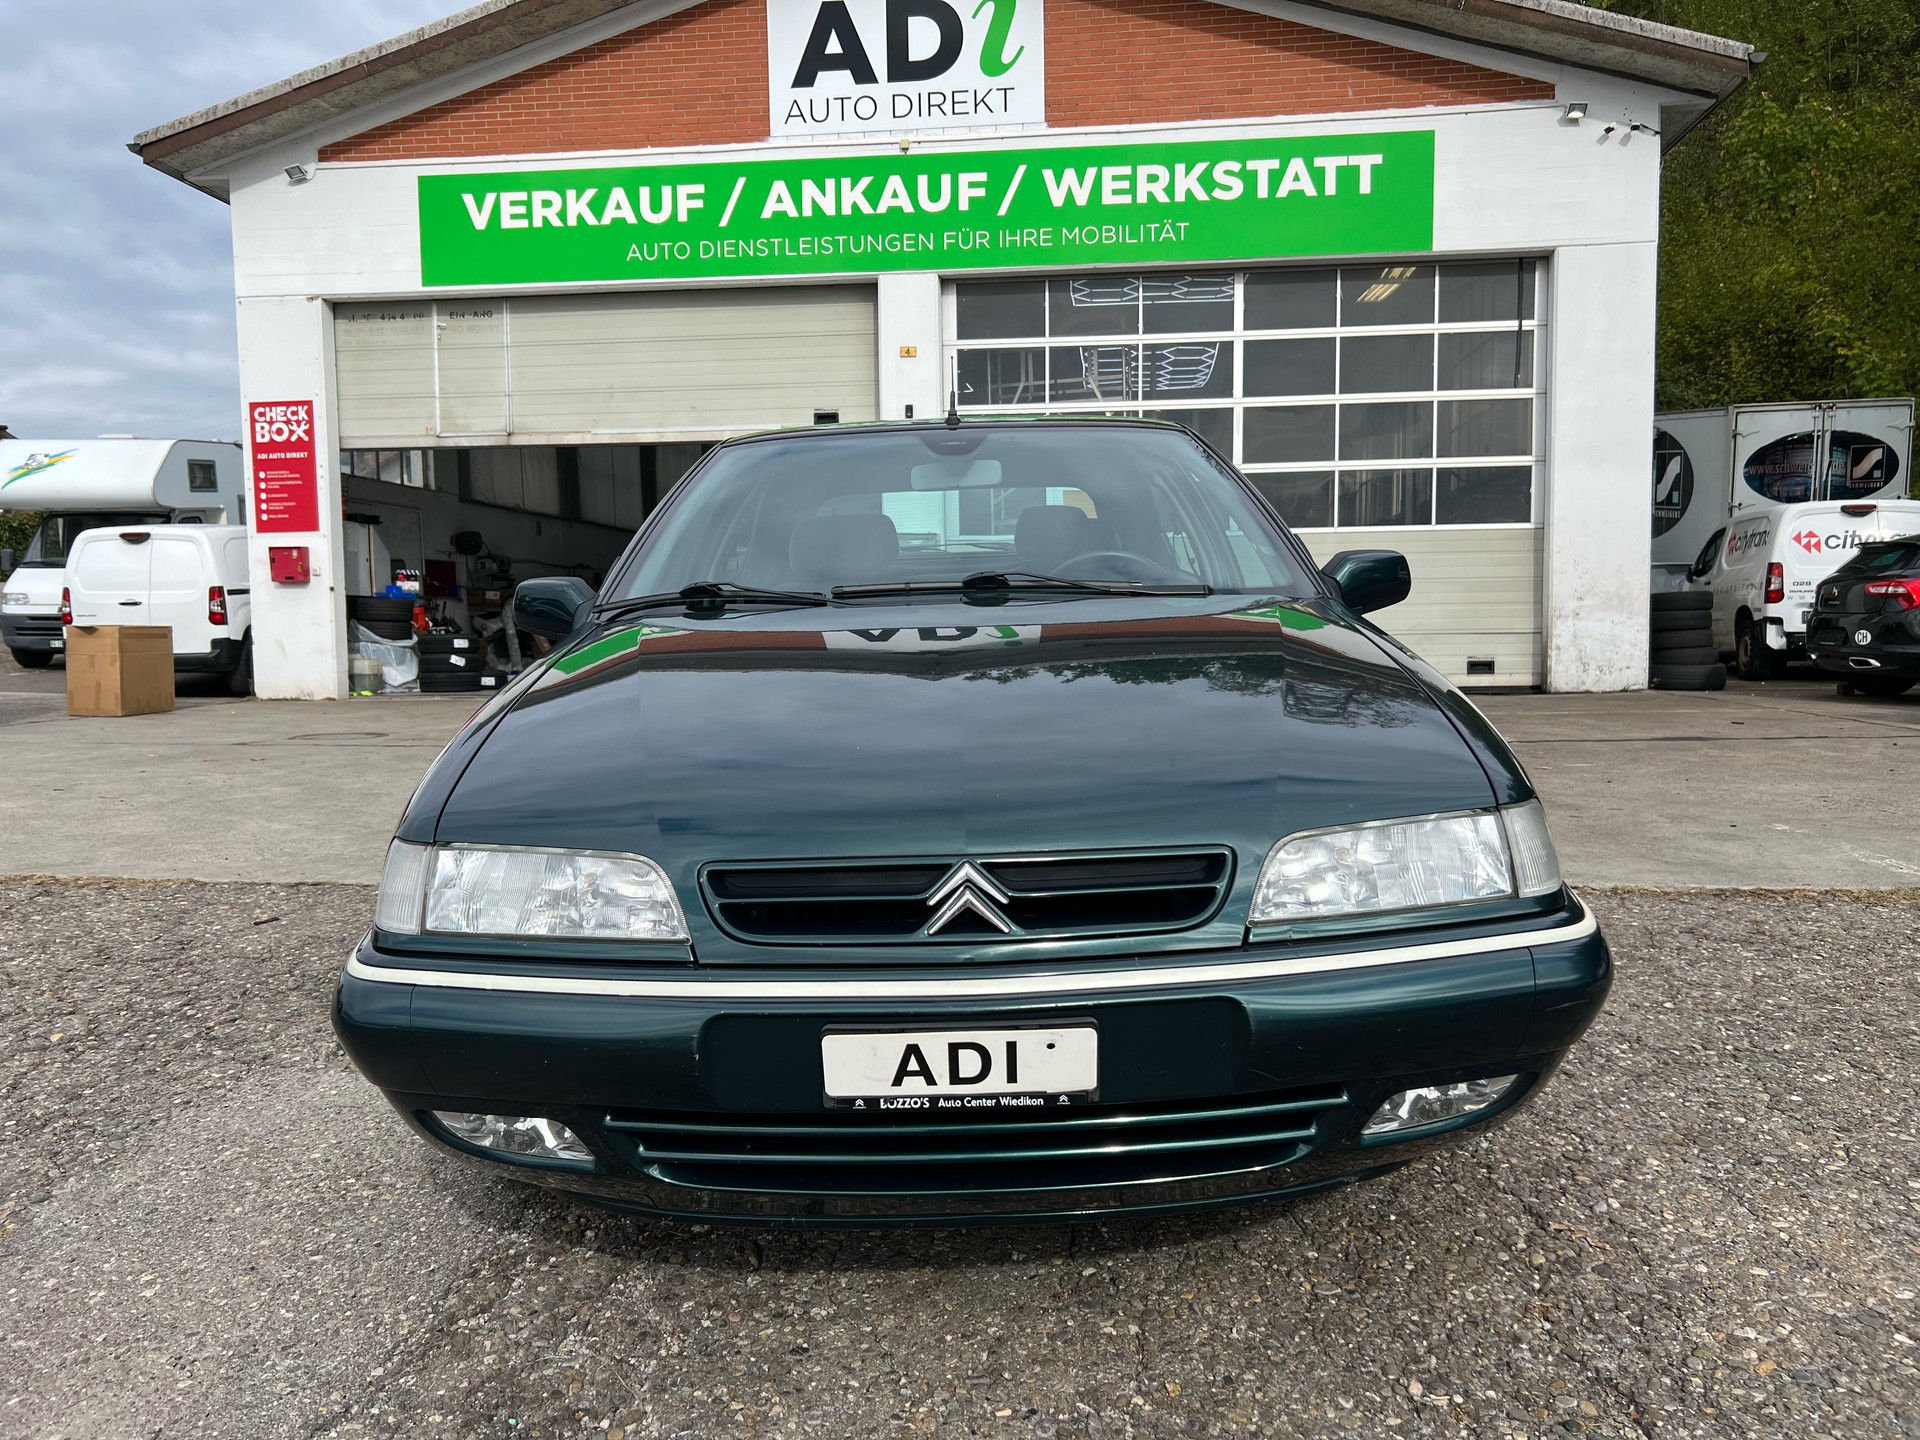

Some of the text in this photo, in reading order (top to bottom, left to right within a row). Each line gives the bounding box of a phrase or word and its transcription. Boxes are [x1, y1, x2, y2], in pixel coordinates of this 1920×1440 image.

[784, 87, 1015, 125] AUTO DIREKT
[461, 184, 705, 231] VERKAUF
[760, 171, 988, 219] ANKAUF
[1041, 154, 1383, 207] WERKSTATT
[626, 219, 1190, 262] AUTO DIENSTLEISTUNGEN FÜR IHRE MOBILITÄT
[449, 310, 493, 319] EINANG
[254, 405, 309, 422] CHECK
[286, 451, 308, 459] DIREKT
[1857, 632, 1868, 643] CH
[891, 1040, 1018, 1088] ADI
[938, 1098, 962, 1107] Auto
[963, 1097, 996, 1107] Center
[999, 1096, 1044, 1107] Wiedikon
